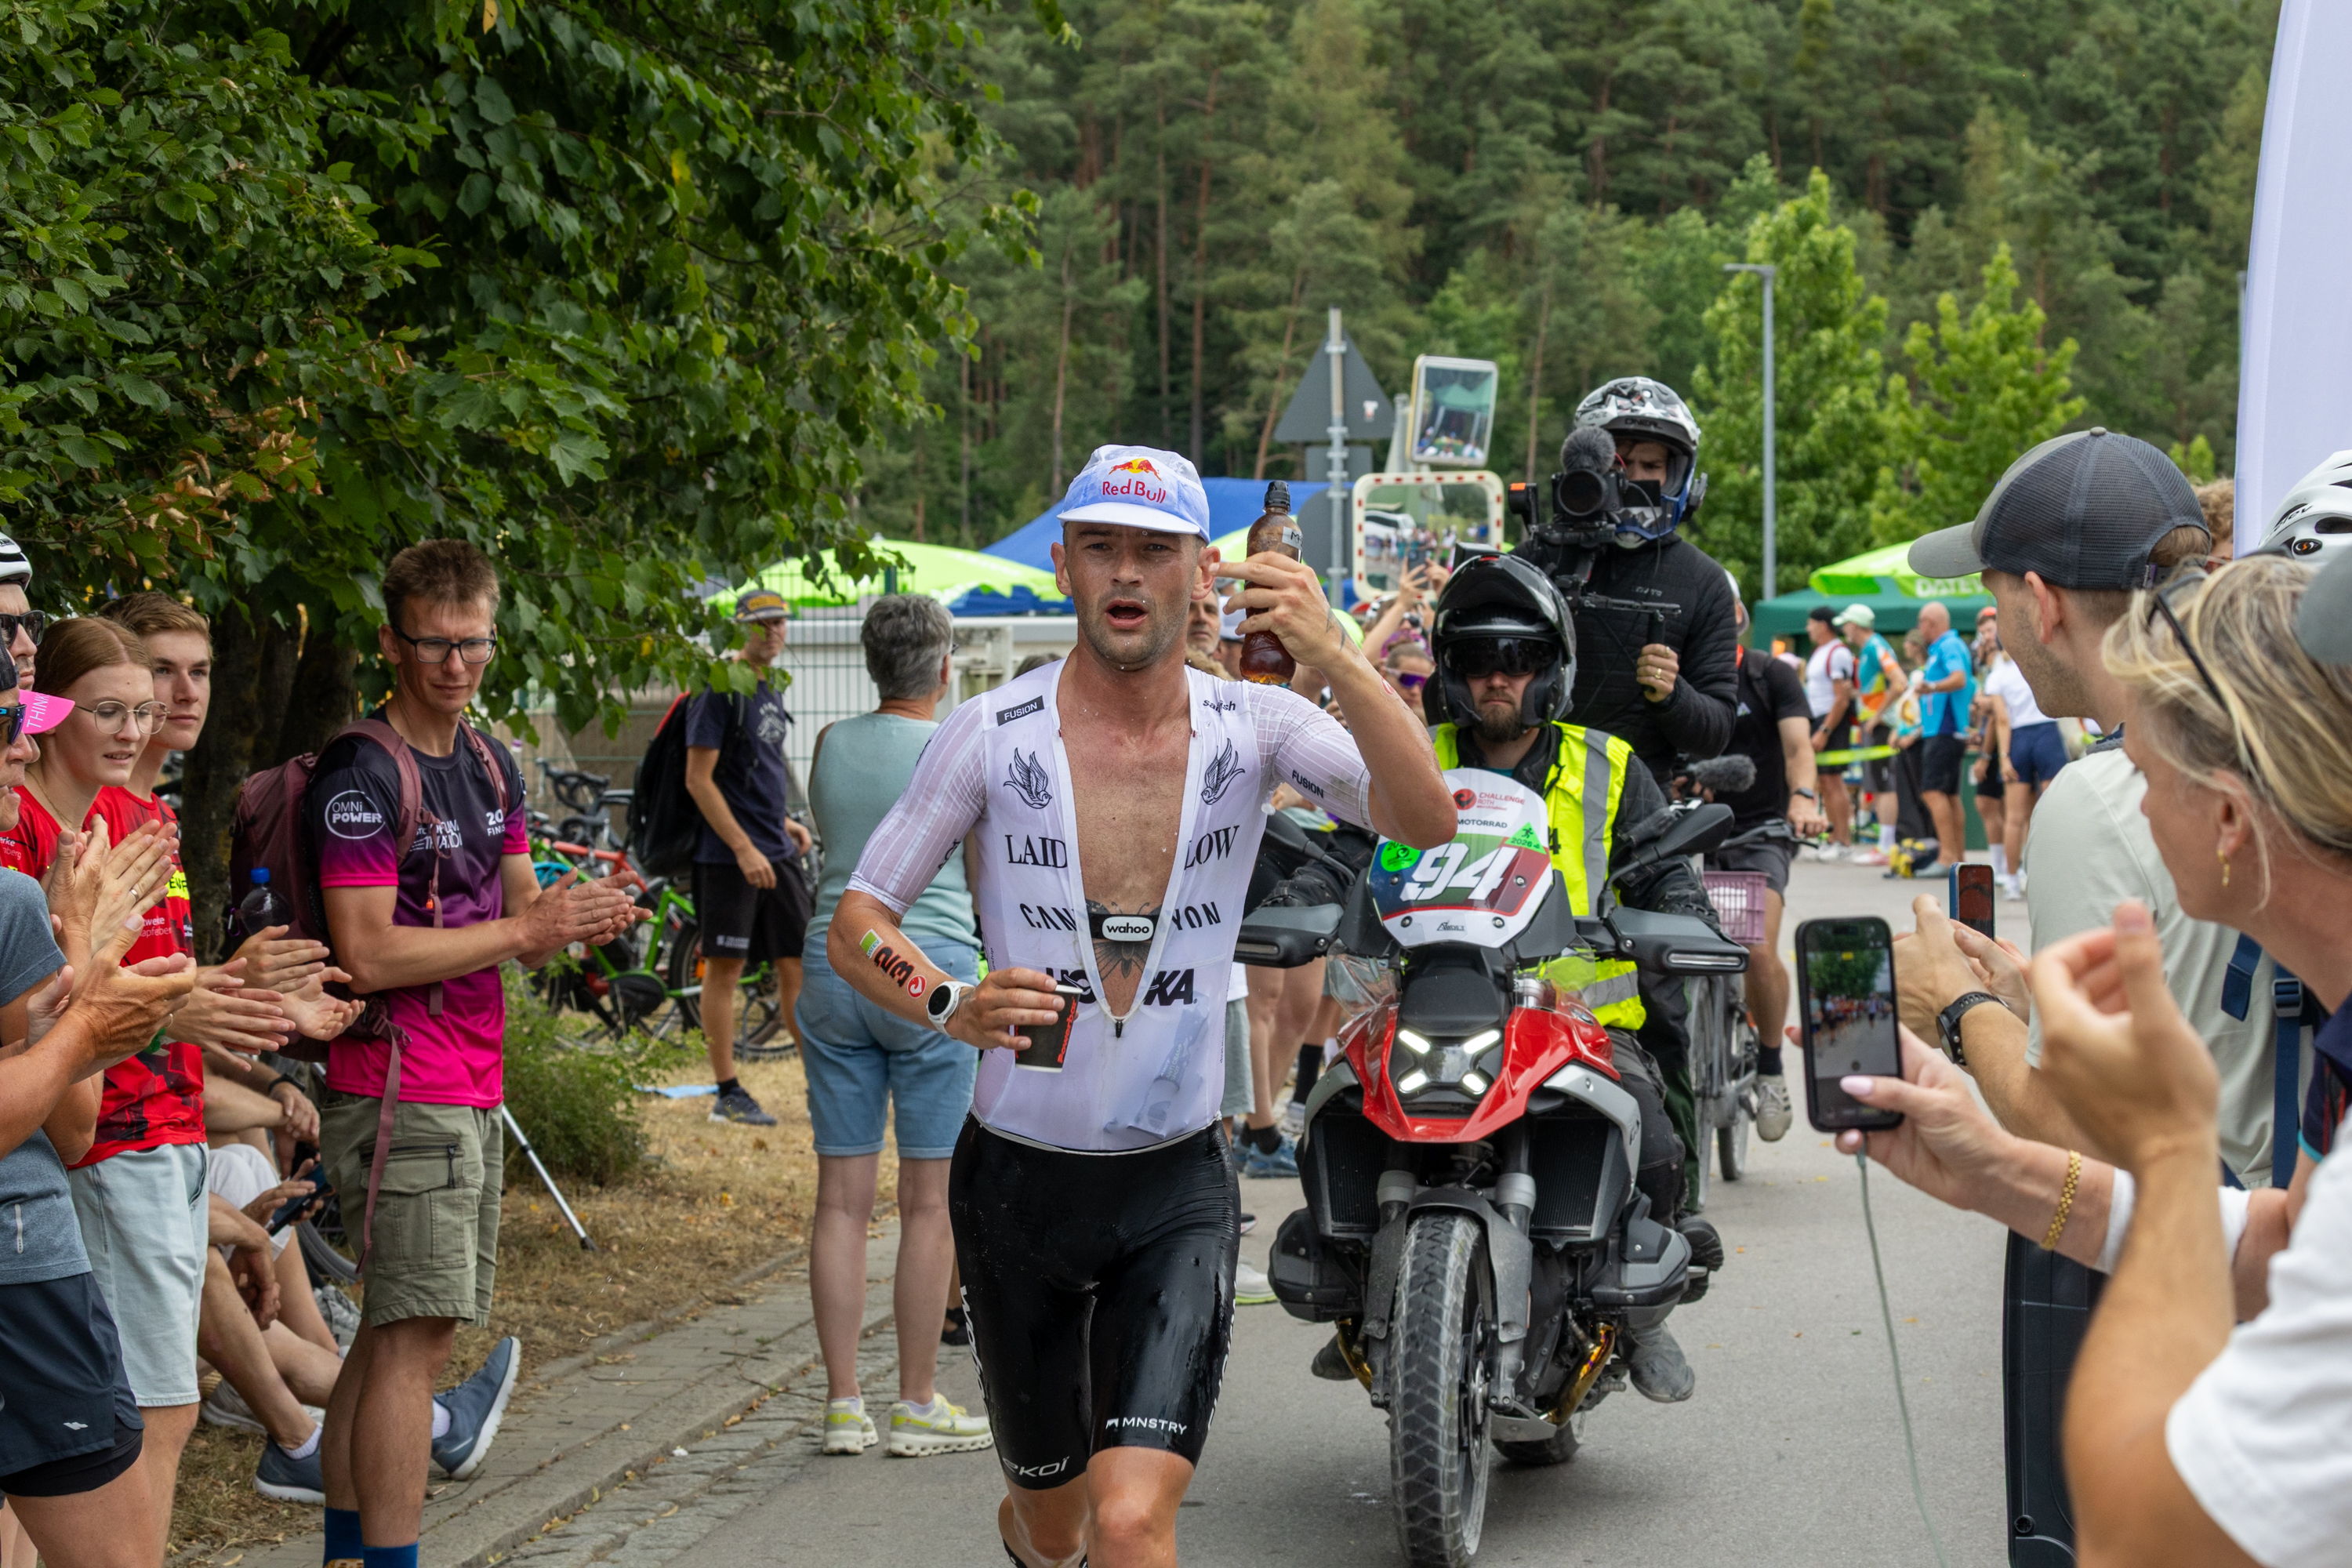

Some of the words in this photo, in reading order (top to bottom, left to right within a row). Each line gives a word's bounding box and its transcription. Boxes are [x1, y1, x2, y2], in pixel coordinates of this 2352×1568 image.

[1102, 478, 1131, 495] Red
[1134, 481, 1166, 503] Bull
[1004, 702, 1037, 720] FUSION
[1292, 770, 1324, 799] FUSION
[332, 801, 363, 812] OMNi
[1479, 792, 1526, 805] CHALLENGE
[332, 812, 382, 823] POWER
[1457, 818, 1508, 828] MOTORRAD
[1004, 834, 1068, 869] LAID
[1184, 826, 1240, 870] LOW
[1399, 843, 1519, 902] 94
[1019, 903, 1077, 931] CAN
[1171, 902, 1221, 931] YON
[1106, 922, 1149, 934] wahoo
[1123, 1417, 1188, 1436] MNSTRY
